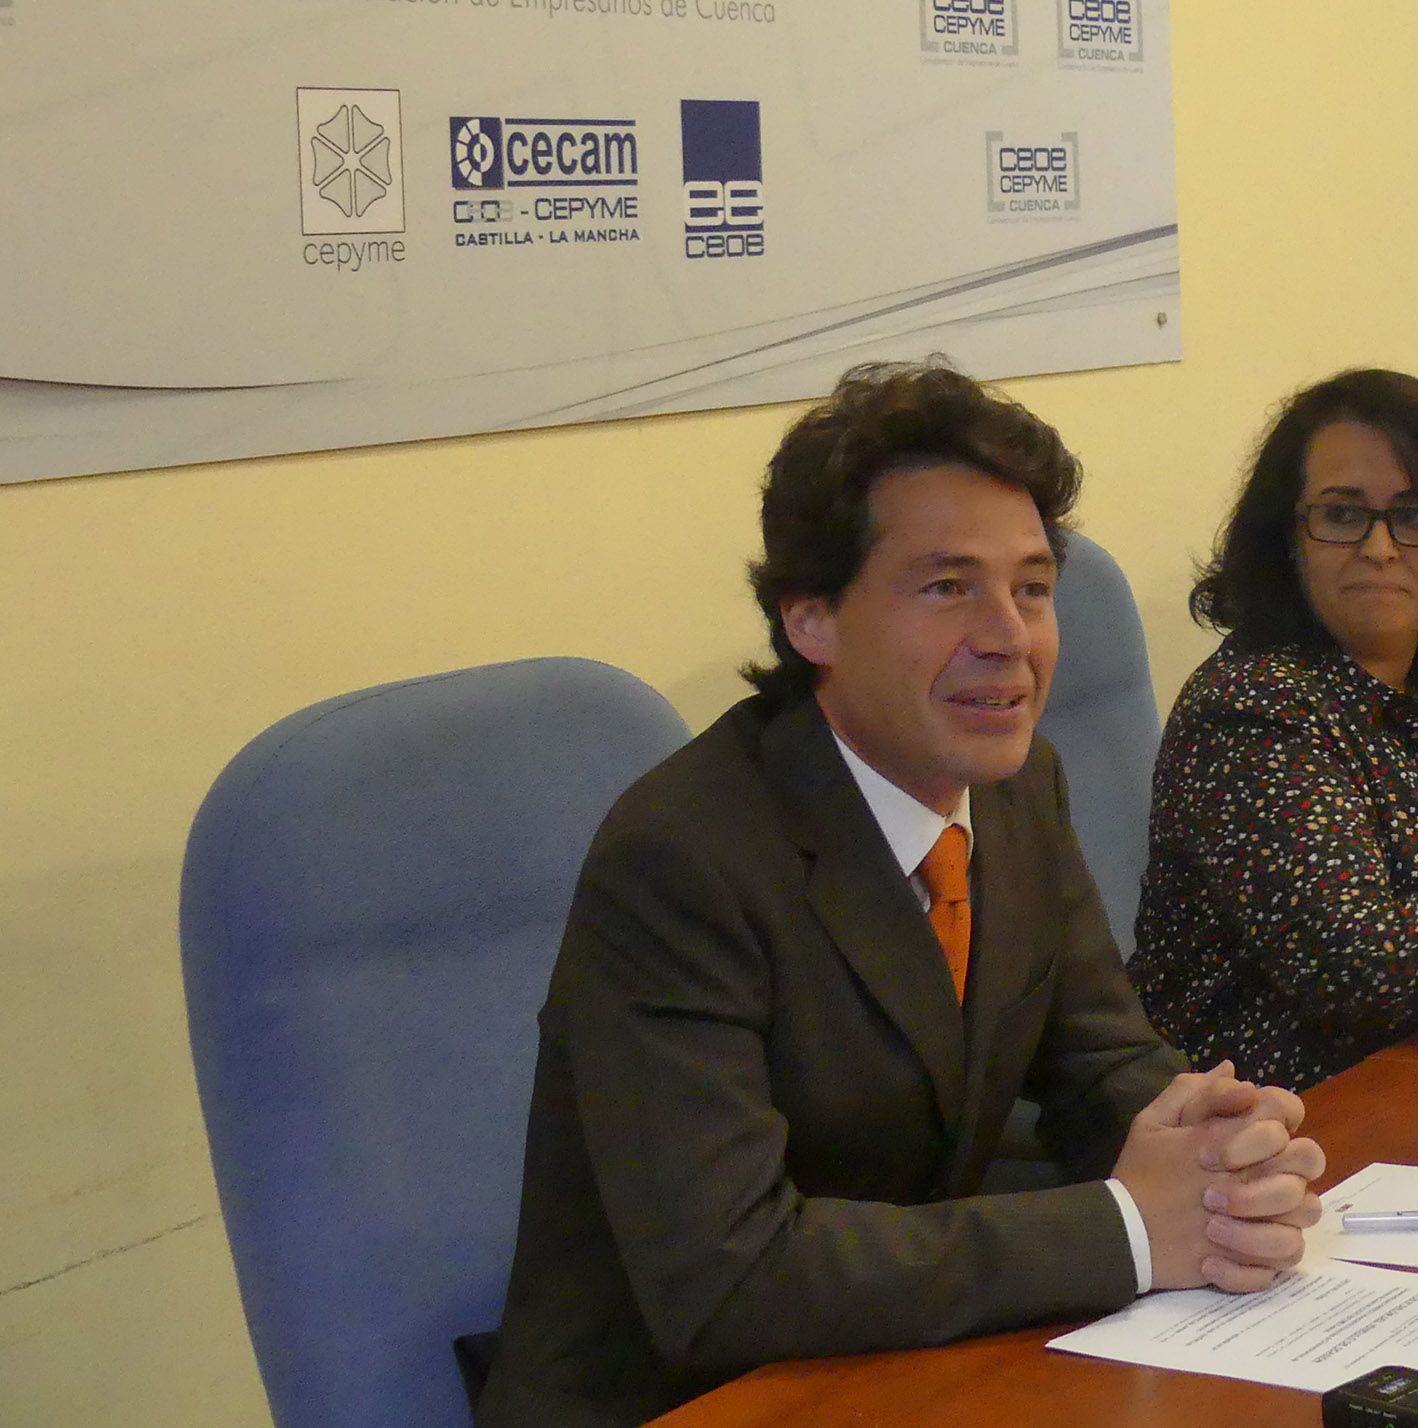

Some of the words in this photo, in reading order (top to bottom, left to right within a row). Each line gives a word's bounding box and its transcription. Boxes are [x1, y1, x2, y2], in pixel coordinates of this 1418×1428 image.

[696, 0, 776, 24] Cuenca
[933, 15, 1006, 37] CEPYME
[1069, 23, 1132, 44] CEPYME
[944, 40, 997, 55] CUENCA
[1078, 47, 1125, 62] CUENCA
[507, 131, 638, 175] cecam
[1000, 175, 1068, 193] CEPYME
[535, 197, 638, 220] CEPYME
[1009, 199, 1060, 212] CUENCA
[456, 232, 533, 246] CASTILLA
[550, 229, 568, 243] LA
[574, 228, 640, 241] MANCHA
[303, 236, 406, 271] cepyme
